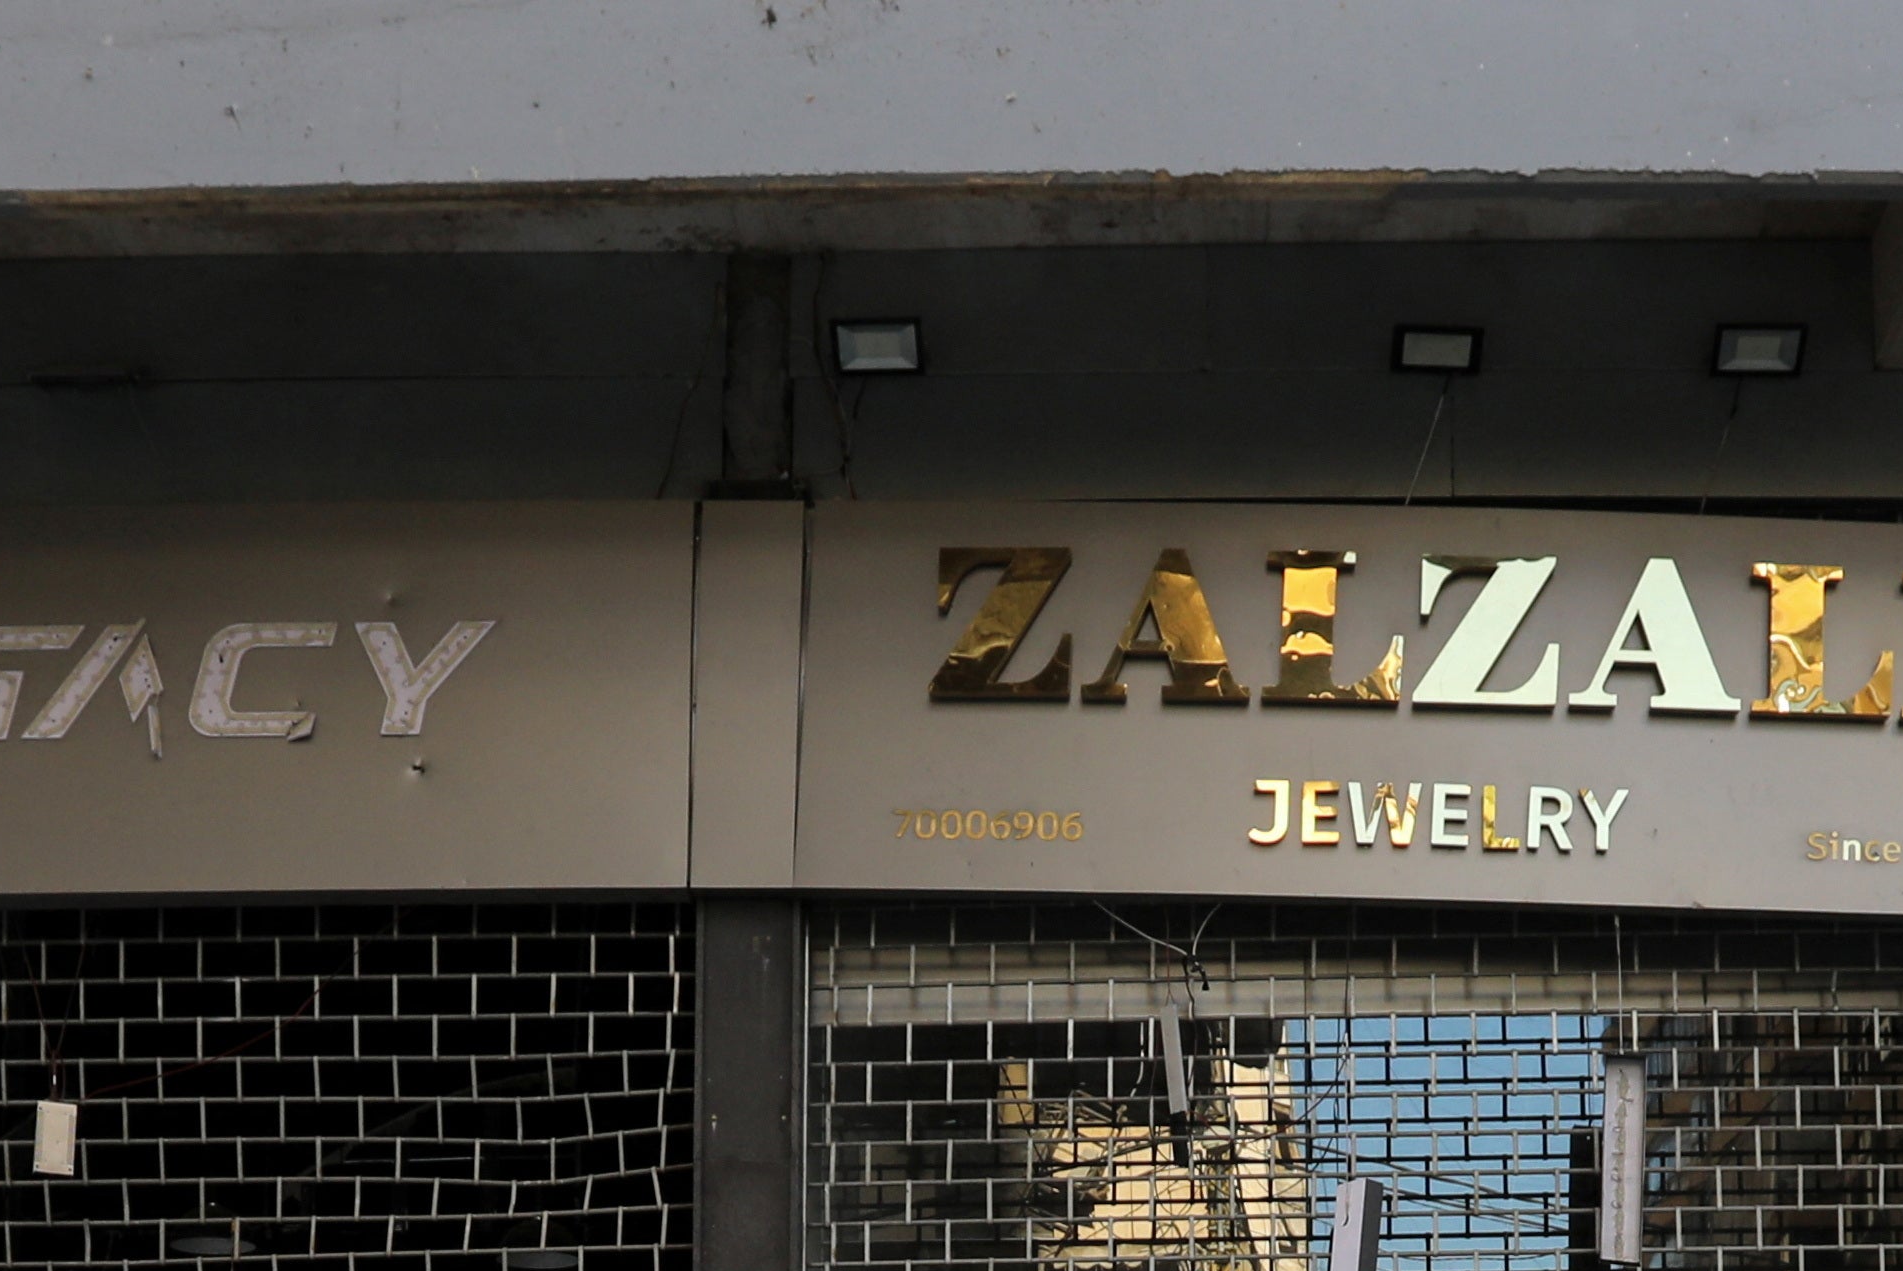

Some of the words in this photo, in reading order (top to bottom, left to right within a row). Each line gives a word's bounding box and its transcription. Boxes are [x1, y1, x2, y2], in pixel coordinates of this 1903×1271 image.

[893, 807, 1085, 845] 70006906
[1248, 779, 1630, 857] JEWELRY
[1805, 829, 1903, 866] Since
